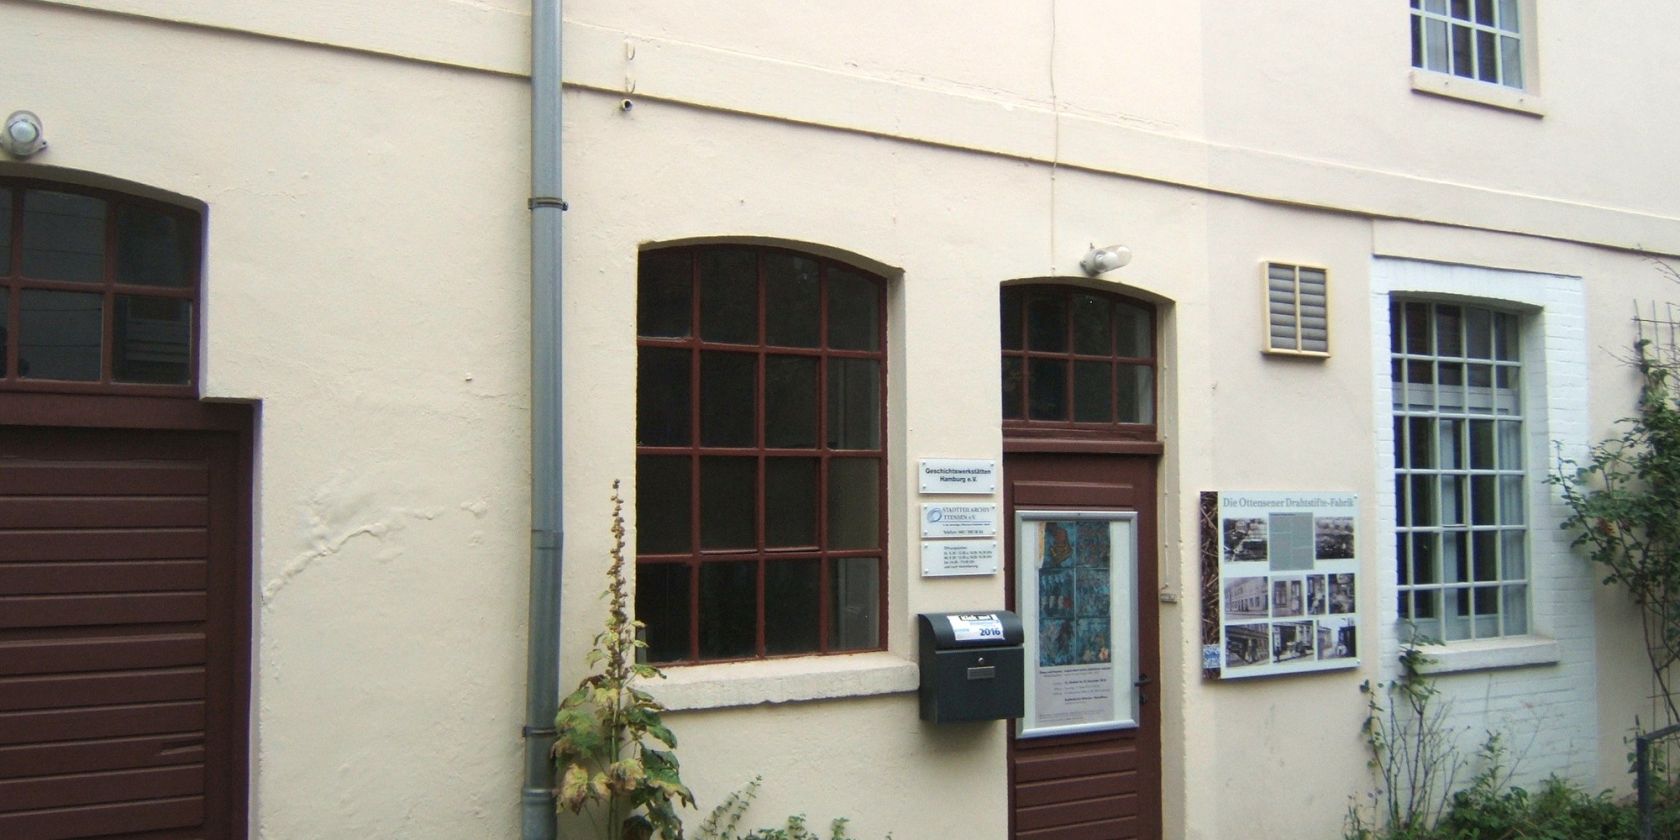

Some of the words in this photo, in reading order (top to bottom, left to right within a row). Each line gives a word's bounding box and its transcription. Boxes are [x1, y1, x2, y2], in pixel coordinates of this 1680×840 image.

[1223, 498, 1237, 507] Die
[1239, 497, 1284, 507] Ottensener
[980, 628, 1001, 636] 2016
